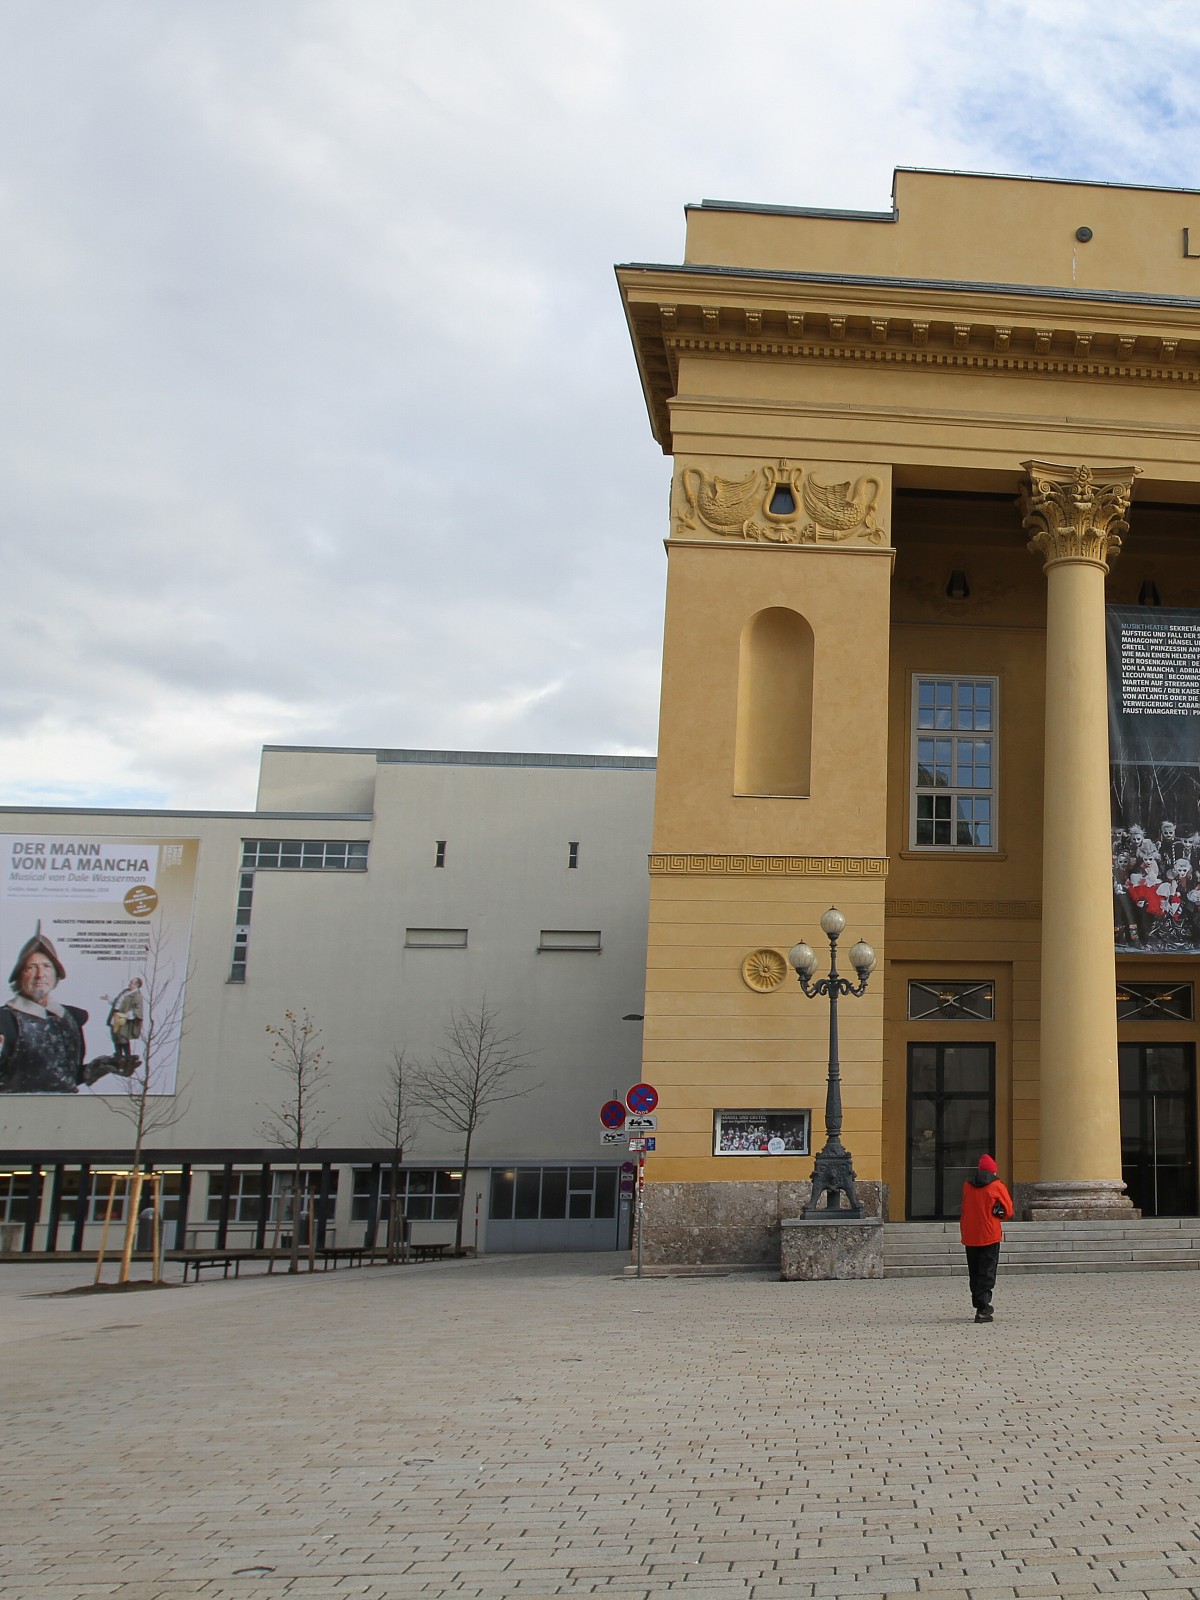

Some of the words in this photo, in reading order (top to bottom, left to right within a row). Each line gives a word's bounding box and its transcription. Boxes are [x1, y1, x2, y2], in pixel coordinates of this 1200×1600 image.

[12, 842, 44, 854] DER
[50, 843, 100, 856] MANN
[12, 857, 46, 870] VON
[51, 858, 72, 870] LA
[76, 858, 149, 872] MANCHA
[9, 872, 46, 881] Musical
[68, 873, 88, 882] Dale
[92, 874, 146, 883] Wasserman
